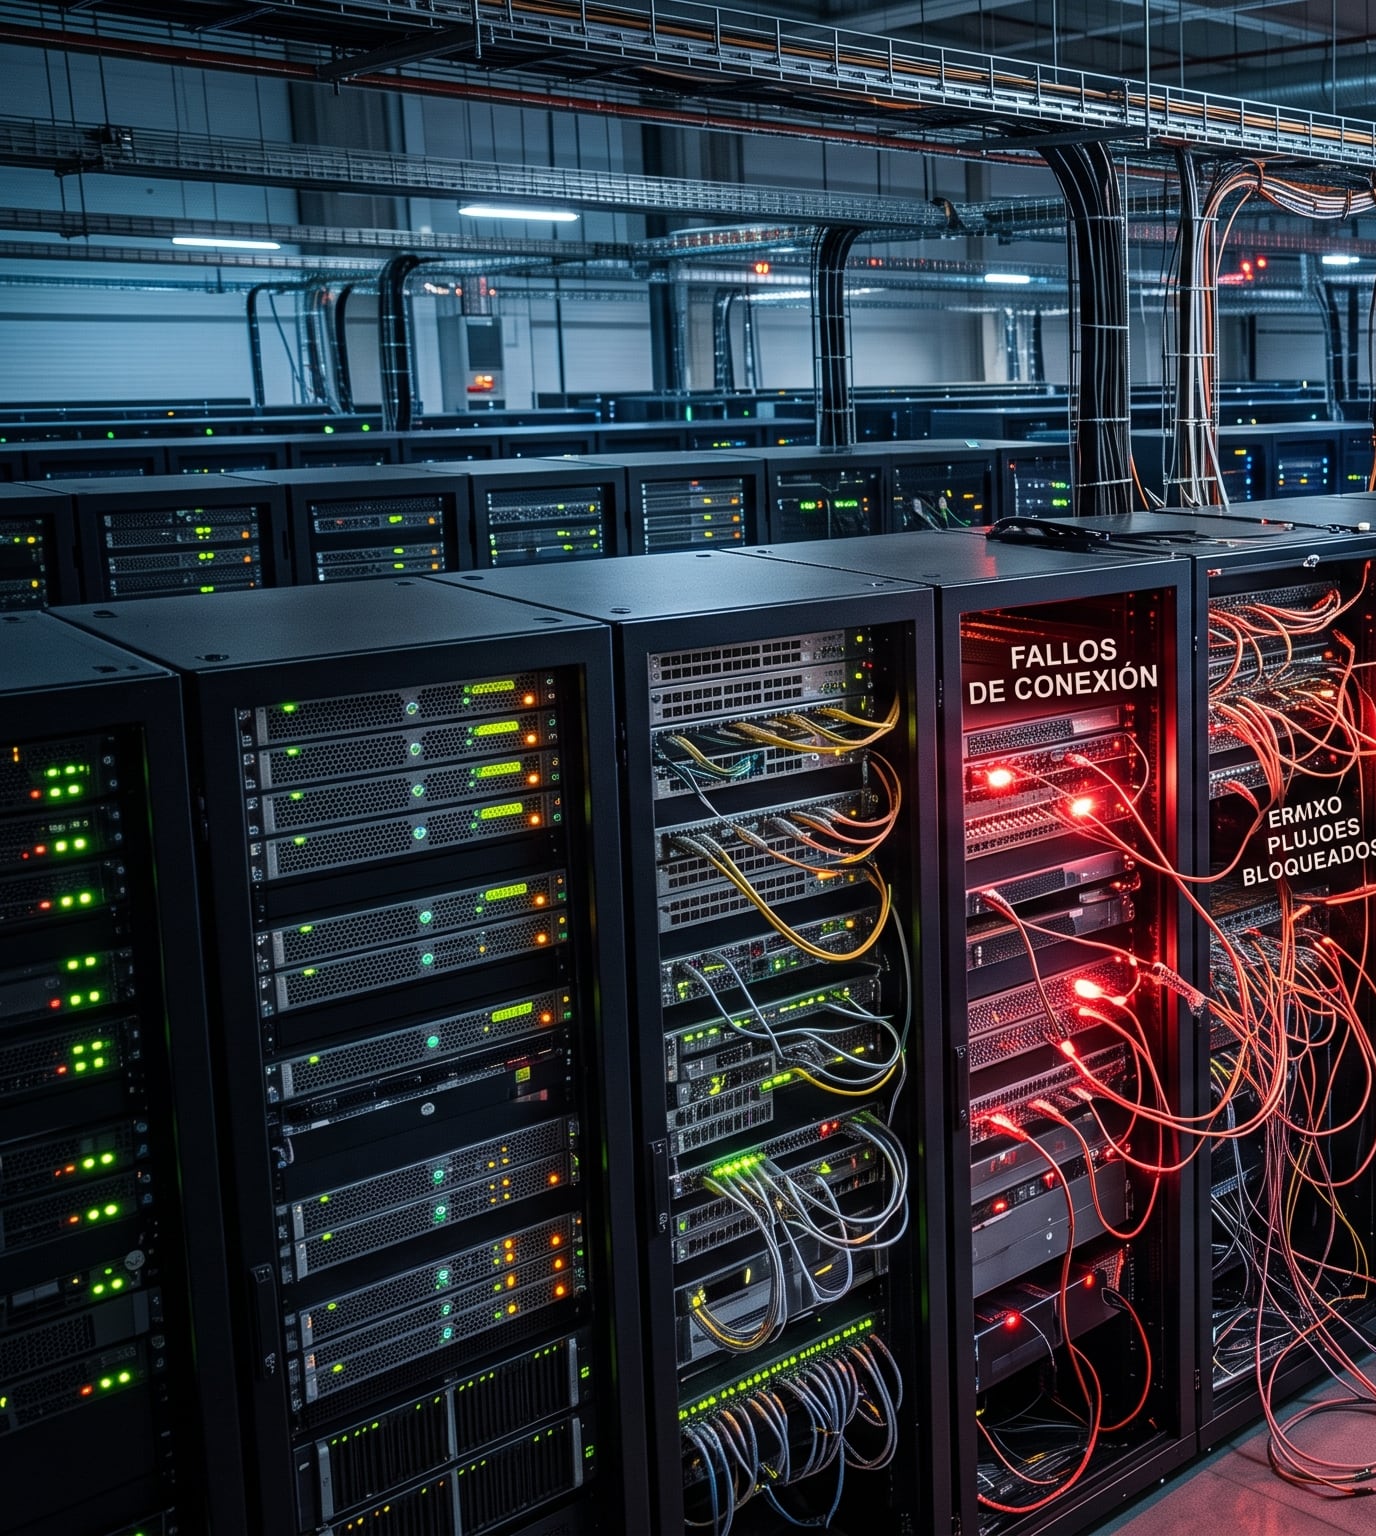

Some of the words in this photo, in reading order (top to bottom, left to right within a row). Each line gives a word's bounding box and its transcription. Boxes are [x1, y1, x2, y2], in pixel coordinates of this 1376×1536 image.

[1011, 638, 1117, 669] FALLOS
[969, 679, 1006, 705] DE
[1014, 661, 1158, 700] CONEXIÓN
[1268, 817, 1360, 855] PLUJOES
